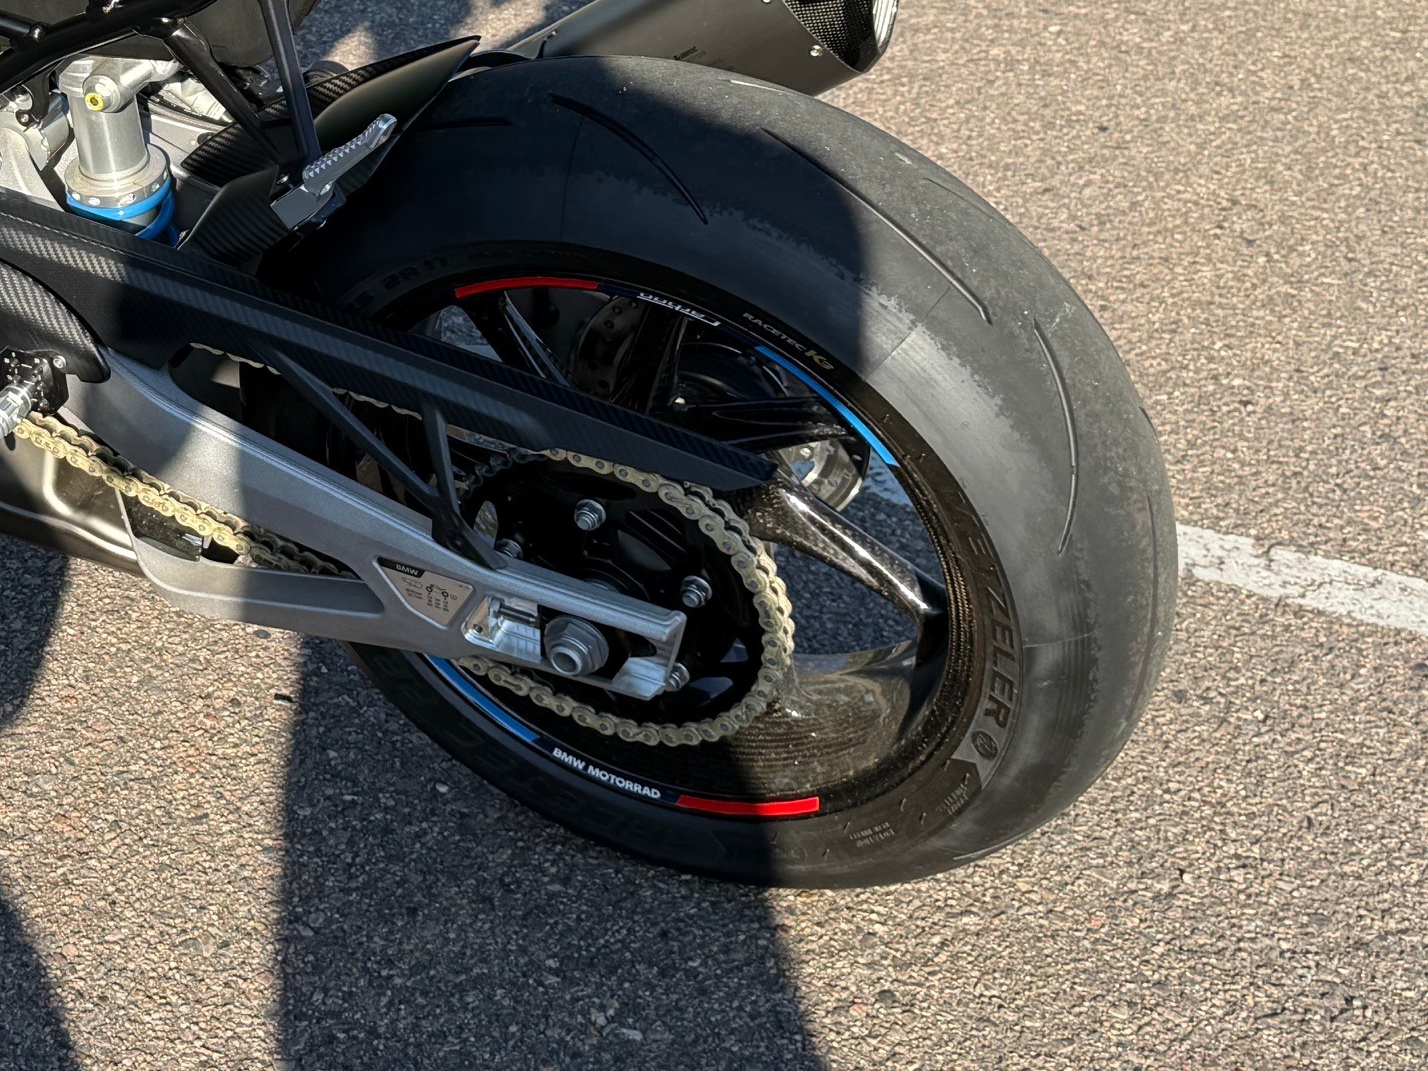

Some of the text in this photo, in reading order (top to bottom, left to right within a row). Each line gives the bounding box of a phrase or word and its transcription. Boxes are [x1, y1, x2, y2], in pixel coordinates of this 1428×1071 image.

[742, 312, 835, 370] RACETEC K3
[395, 563, 419, 576] BMW
[552, 747, 661, 799] BMW MOTORRAD
